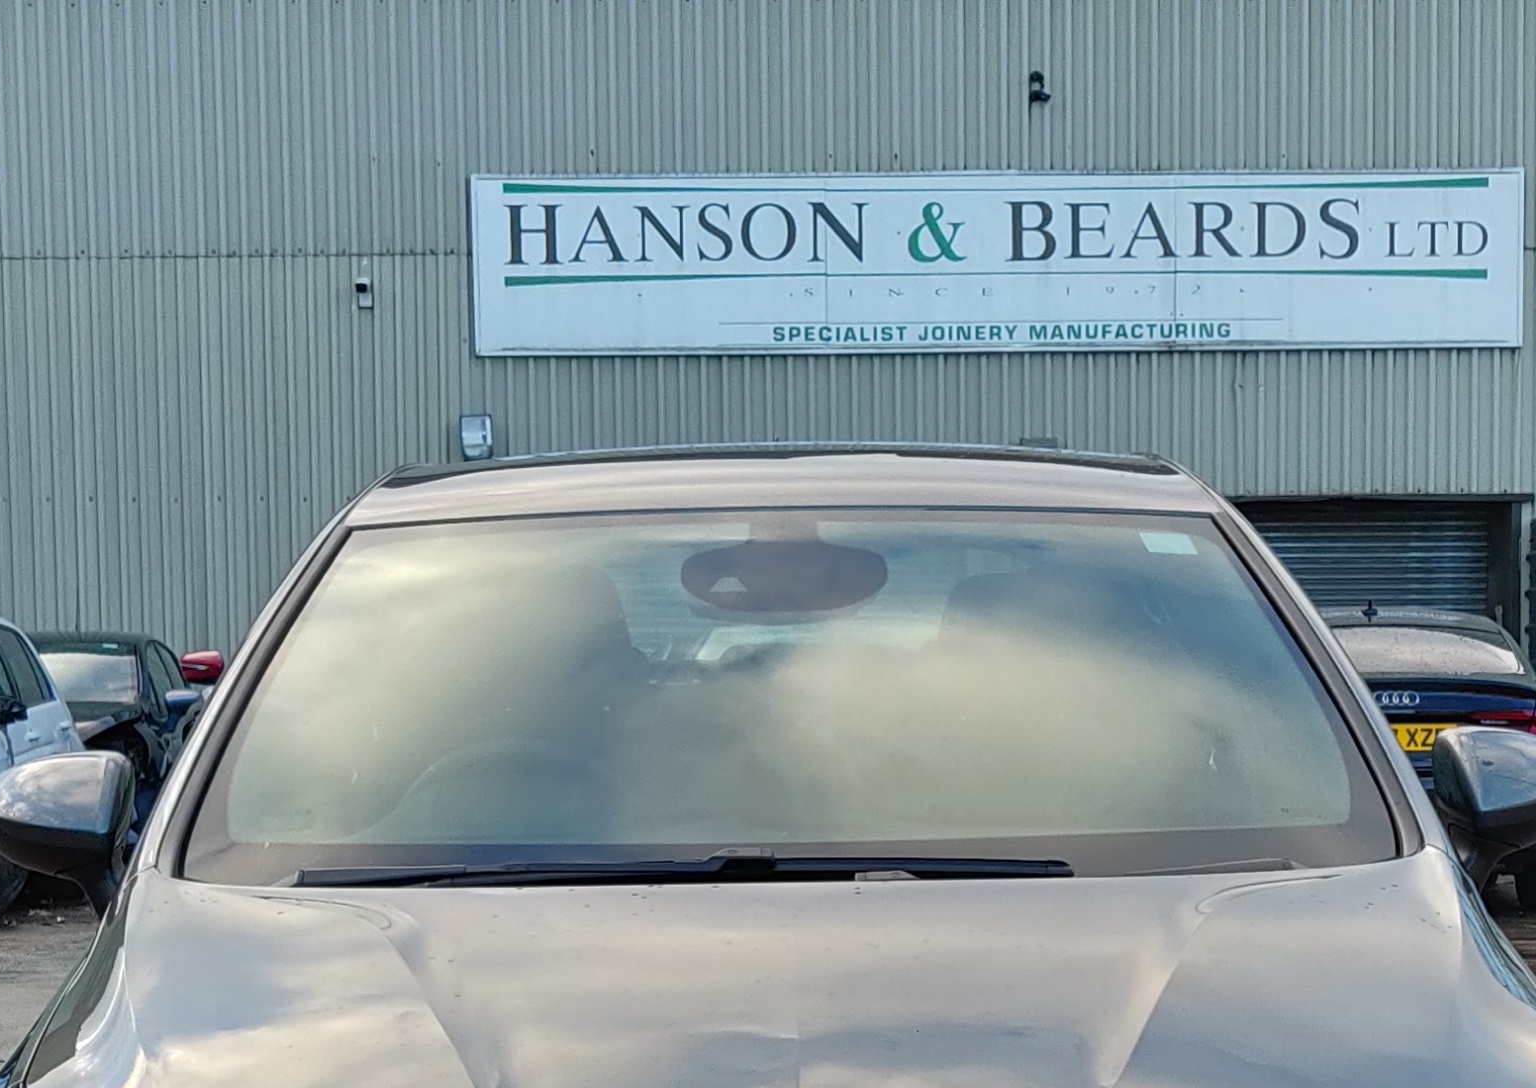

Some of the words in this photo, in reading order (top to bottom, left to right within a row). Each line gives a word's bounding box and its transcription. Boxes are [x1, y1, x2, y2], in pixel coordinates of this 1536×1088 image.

[503, 201, 870, 266] HANSON
[907, 201, 967, 264] &
[1004, 197, 1361, 263] BEARDS
[1385, 220, 1489, 258] LTD
[803, 286, 994, 298] SINCE
[771, 325, 908, 343] SPECIALIST
[917, 323, 1019, 343] JOINERY
[1028, 321, 1233, 342] MANUFACTURING
[1406, 727, 1446, 748] XZ
